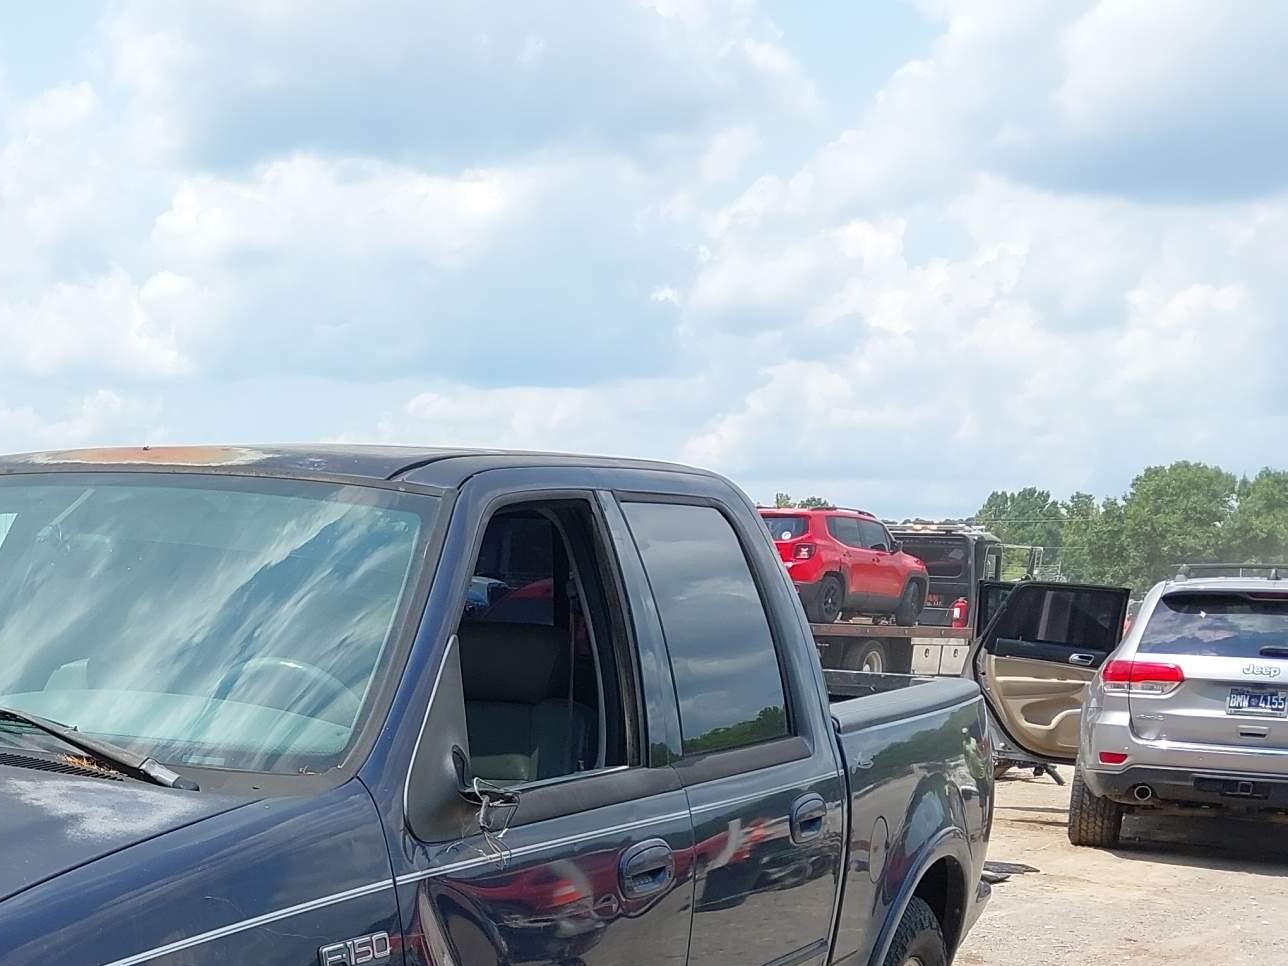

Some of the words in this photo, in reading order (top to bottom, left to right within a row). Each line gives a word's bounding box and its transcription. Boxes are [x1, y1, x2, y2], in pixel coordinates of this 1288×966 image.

[1242, 663, 1281, 679] Jeep
[1230, 694, 1249, 708] BMW
[1259, 695, 1285, 709] 4155
